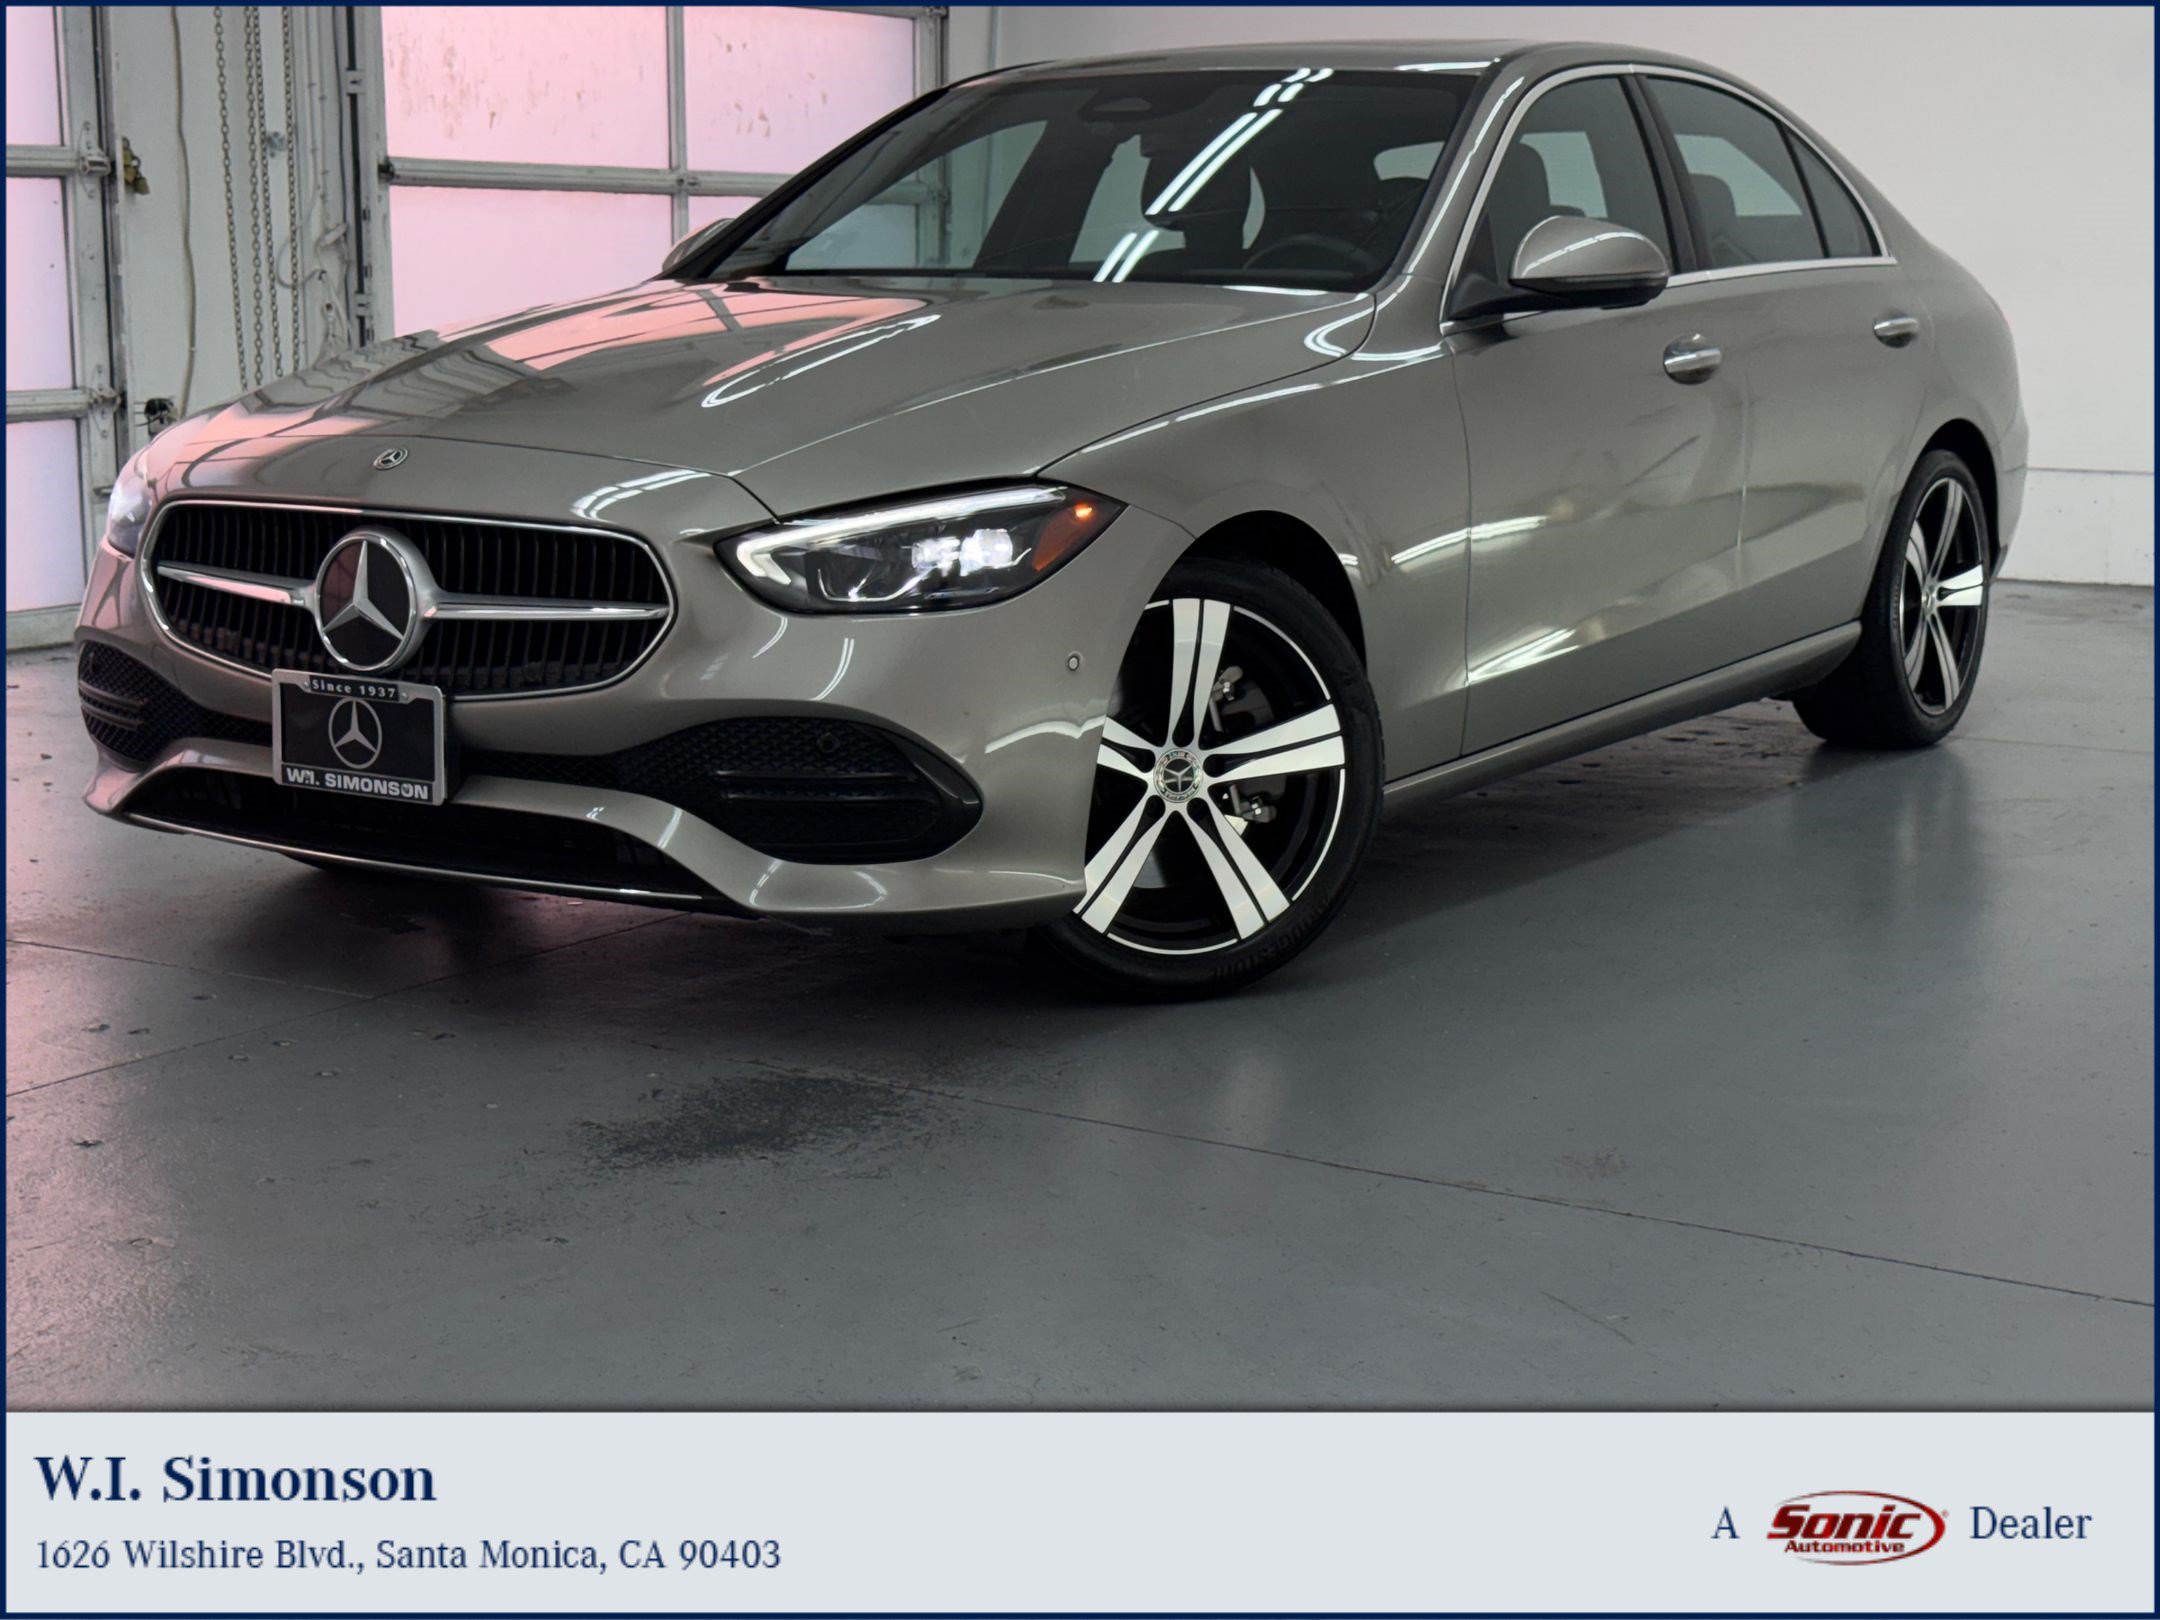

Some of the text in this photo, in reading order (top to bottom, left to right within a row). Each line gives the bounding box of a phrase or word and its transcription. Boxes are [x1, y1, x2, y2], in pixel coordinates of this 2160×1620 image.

[311, 678, 397, 698] Since 1937
[324, 772, 429, 800] SIMONSON
